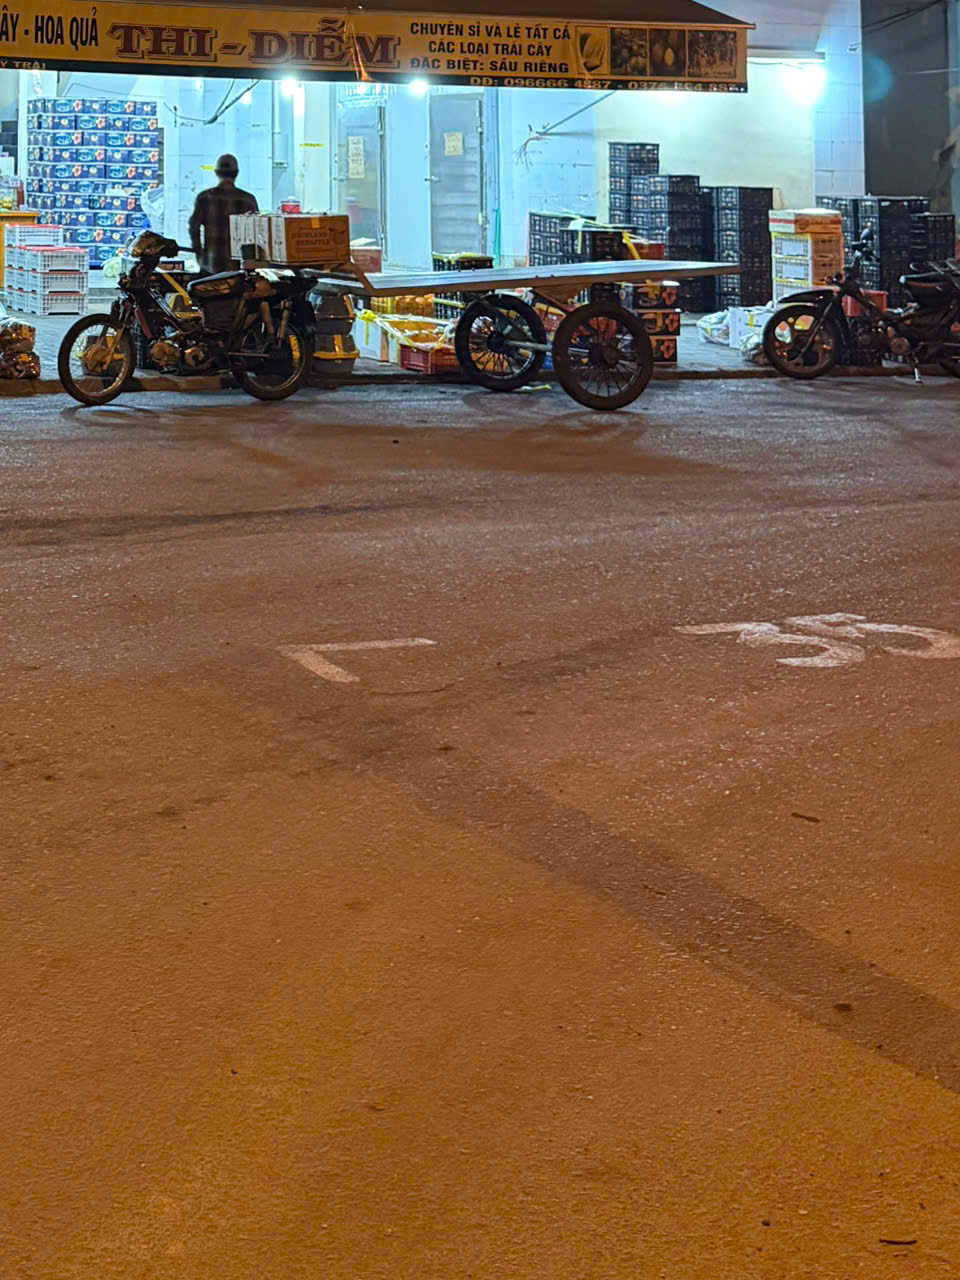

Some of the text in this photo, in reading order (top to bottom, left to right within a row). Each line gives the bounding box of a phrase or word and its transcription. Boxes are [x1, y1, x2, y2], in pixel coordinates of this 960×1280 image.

[34, 14, 65, 45] HOA
[69, 6, 99, 52] QUẢ
[409, 20, 464, 37] CHUYÊN
[485, 22, 502, 38] VÀ
[525, 22, 549, 40] TẤT
[428, 38, 553, 57] CÁC LOẠI TRÁI CÂY
[446, 57, 485, 73] BIỆT:
[523, 59, 569, 73] RIÊNG
